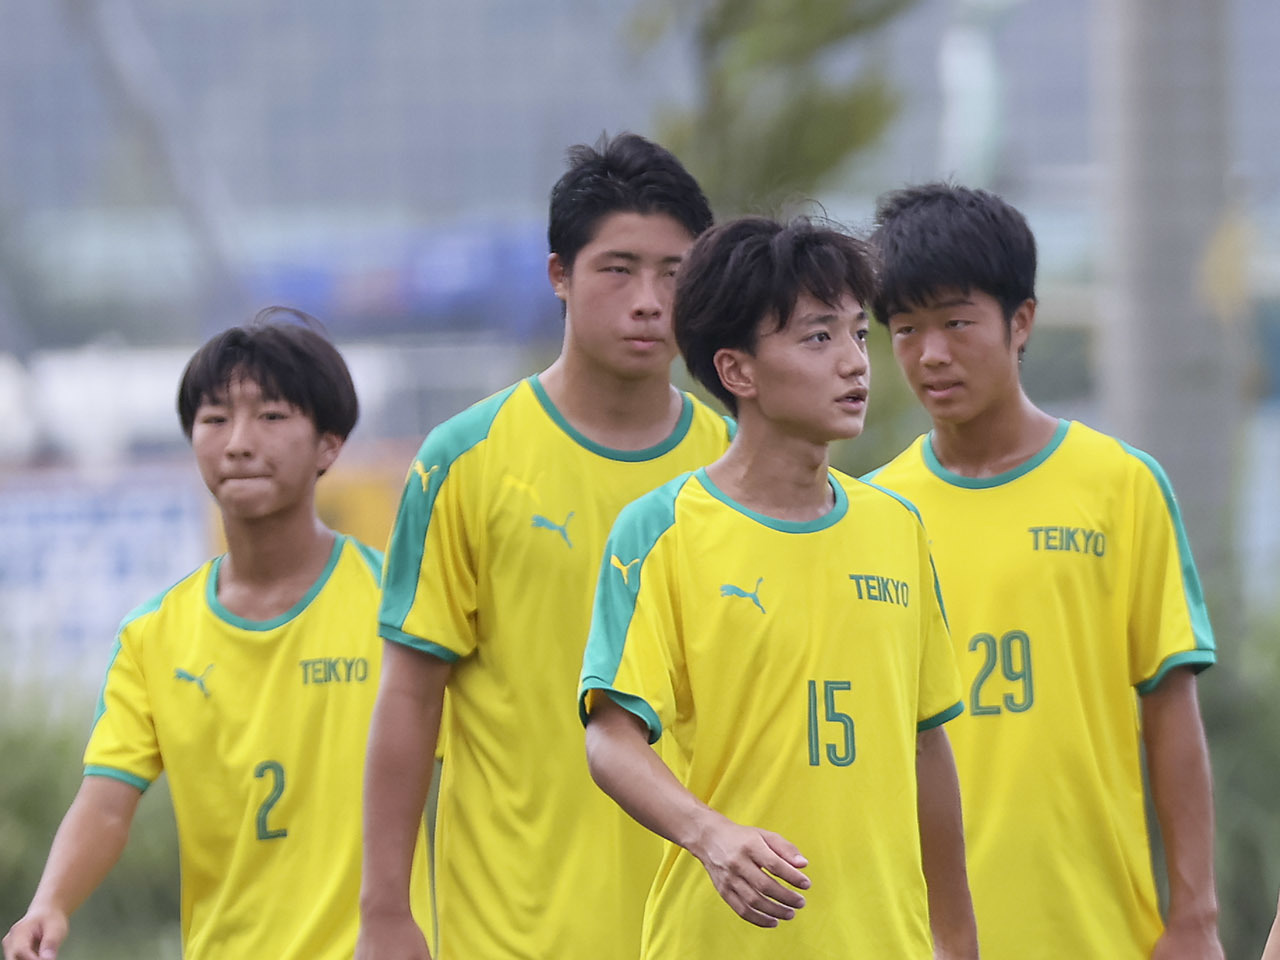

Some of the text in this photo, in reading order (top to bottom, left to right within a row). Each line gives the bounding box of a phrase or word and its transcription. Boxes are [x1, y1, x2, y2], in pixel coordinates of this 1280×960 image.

[1028, 526, 1106, 558] TEIKYO
[848, 573, 910, 608] TEIKYO
[299, 656, 369, 685] TEIKYO
[968, 629, 1035, 717] 29
[807, 679, 857, 768] 15
[253, 759, 289, 842] 2
